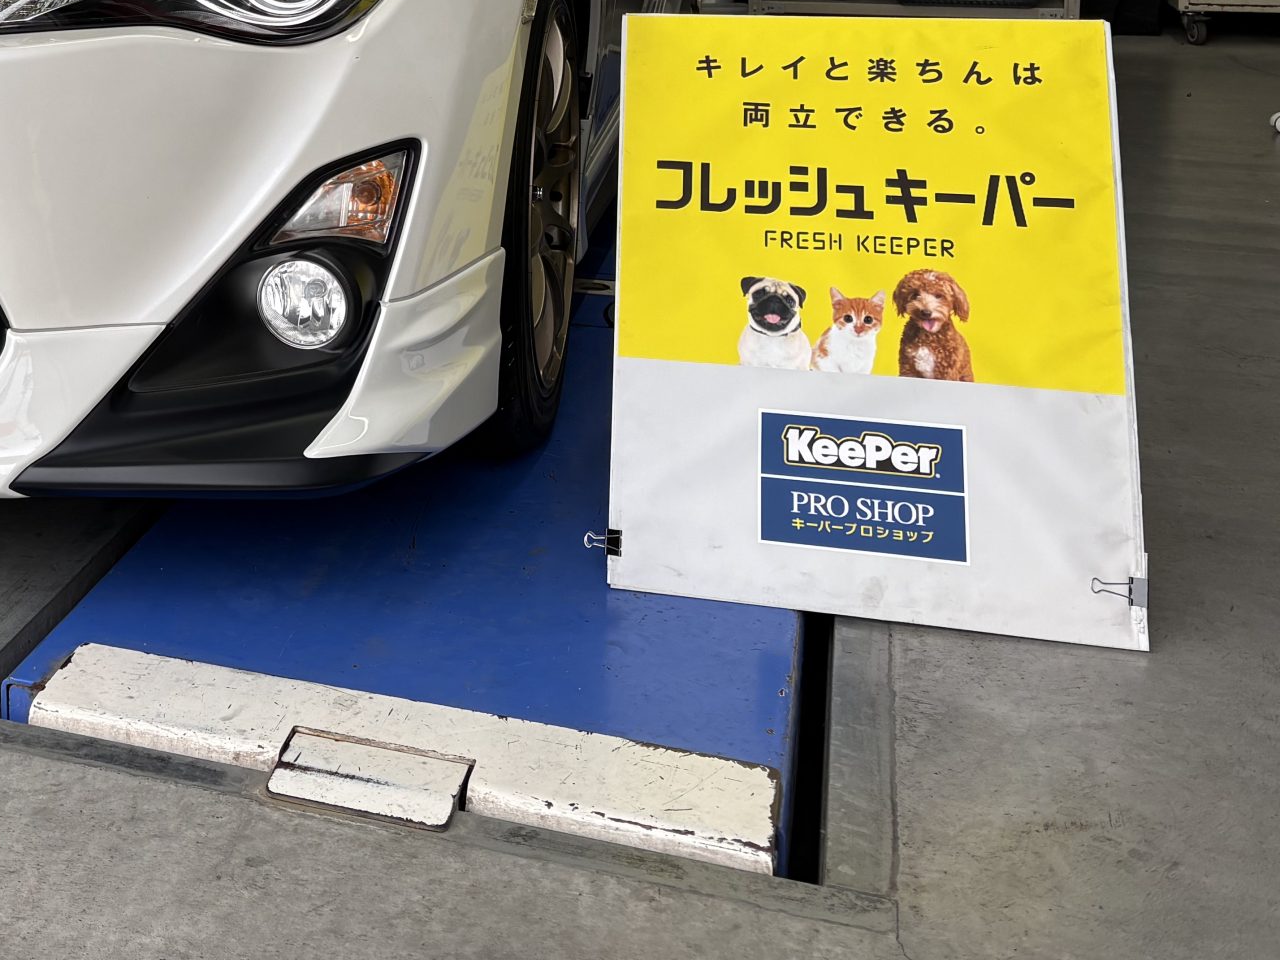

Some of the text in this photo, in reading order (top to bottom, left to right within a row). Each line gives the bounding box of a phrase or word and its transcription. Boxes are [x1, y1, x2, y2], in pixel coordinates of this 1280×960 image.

[696, 54, 1043, 87] キレイと楽ちんは
[742, 101, 986, 135] 両立できる。
[655, 160, 1075, 228] フレッシュキーパー
[764, 230, 955, 258] FRESH KEEPER
[784, 426, 939, 475] KeePer
[790, 490, 935, 527] PRO SHOP
[791, 517, 935, 544] キーパープロショップ
